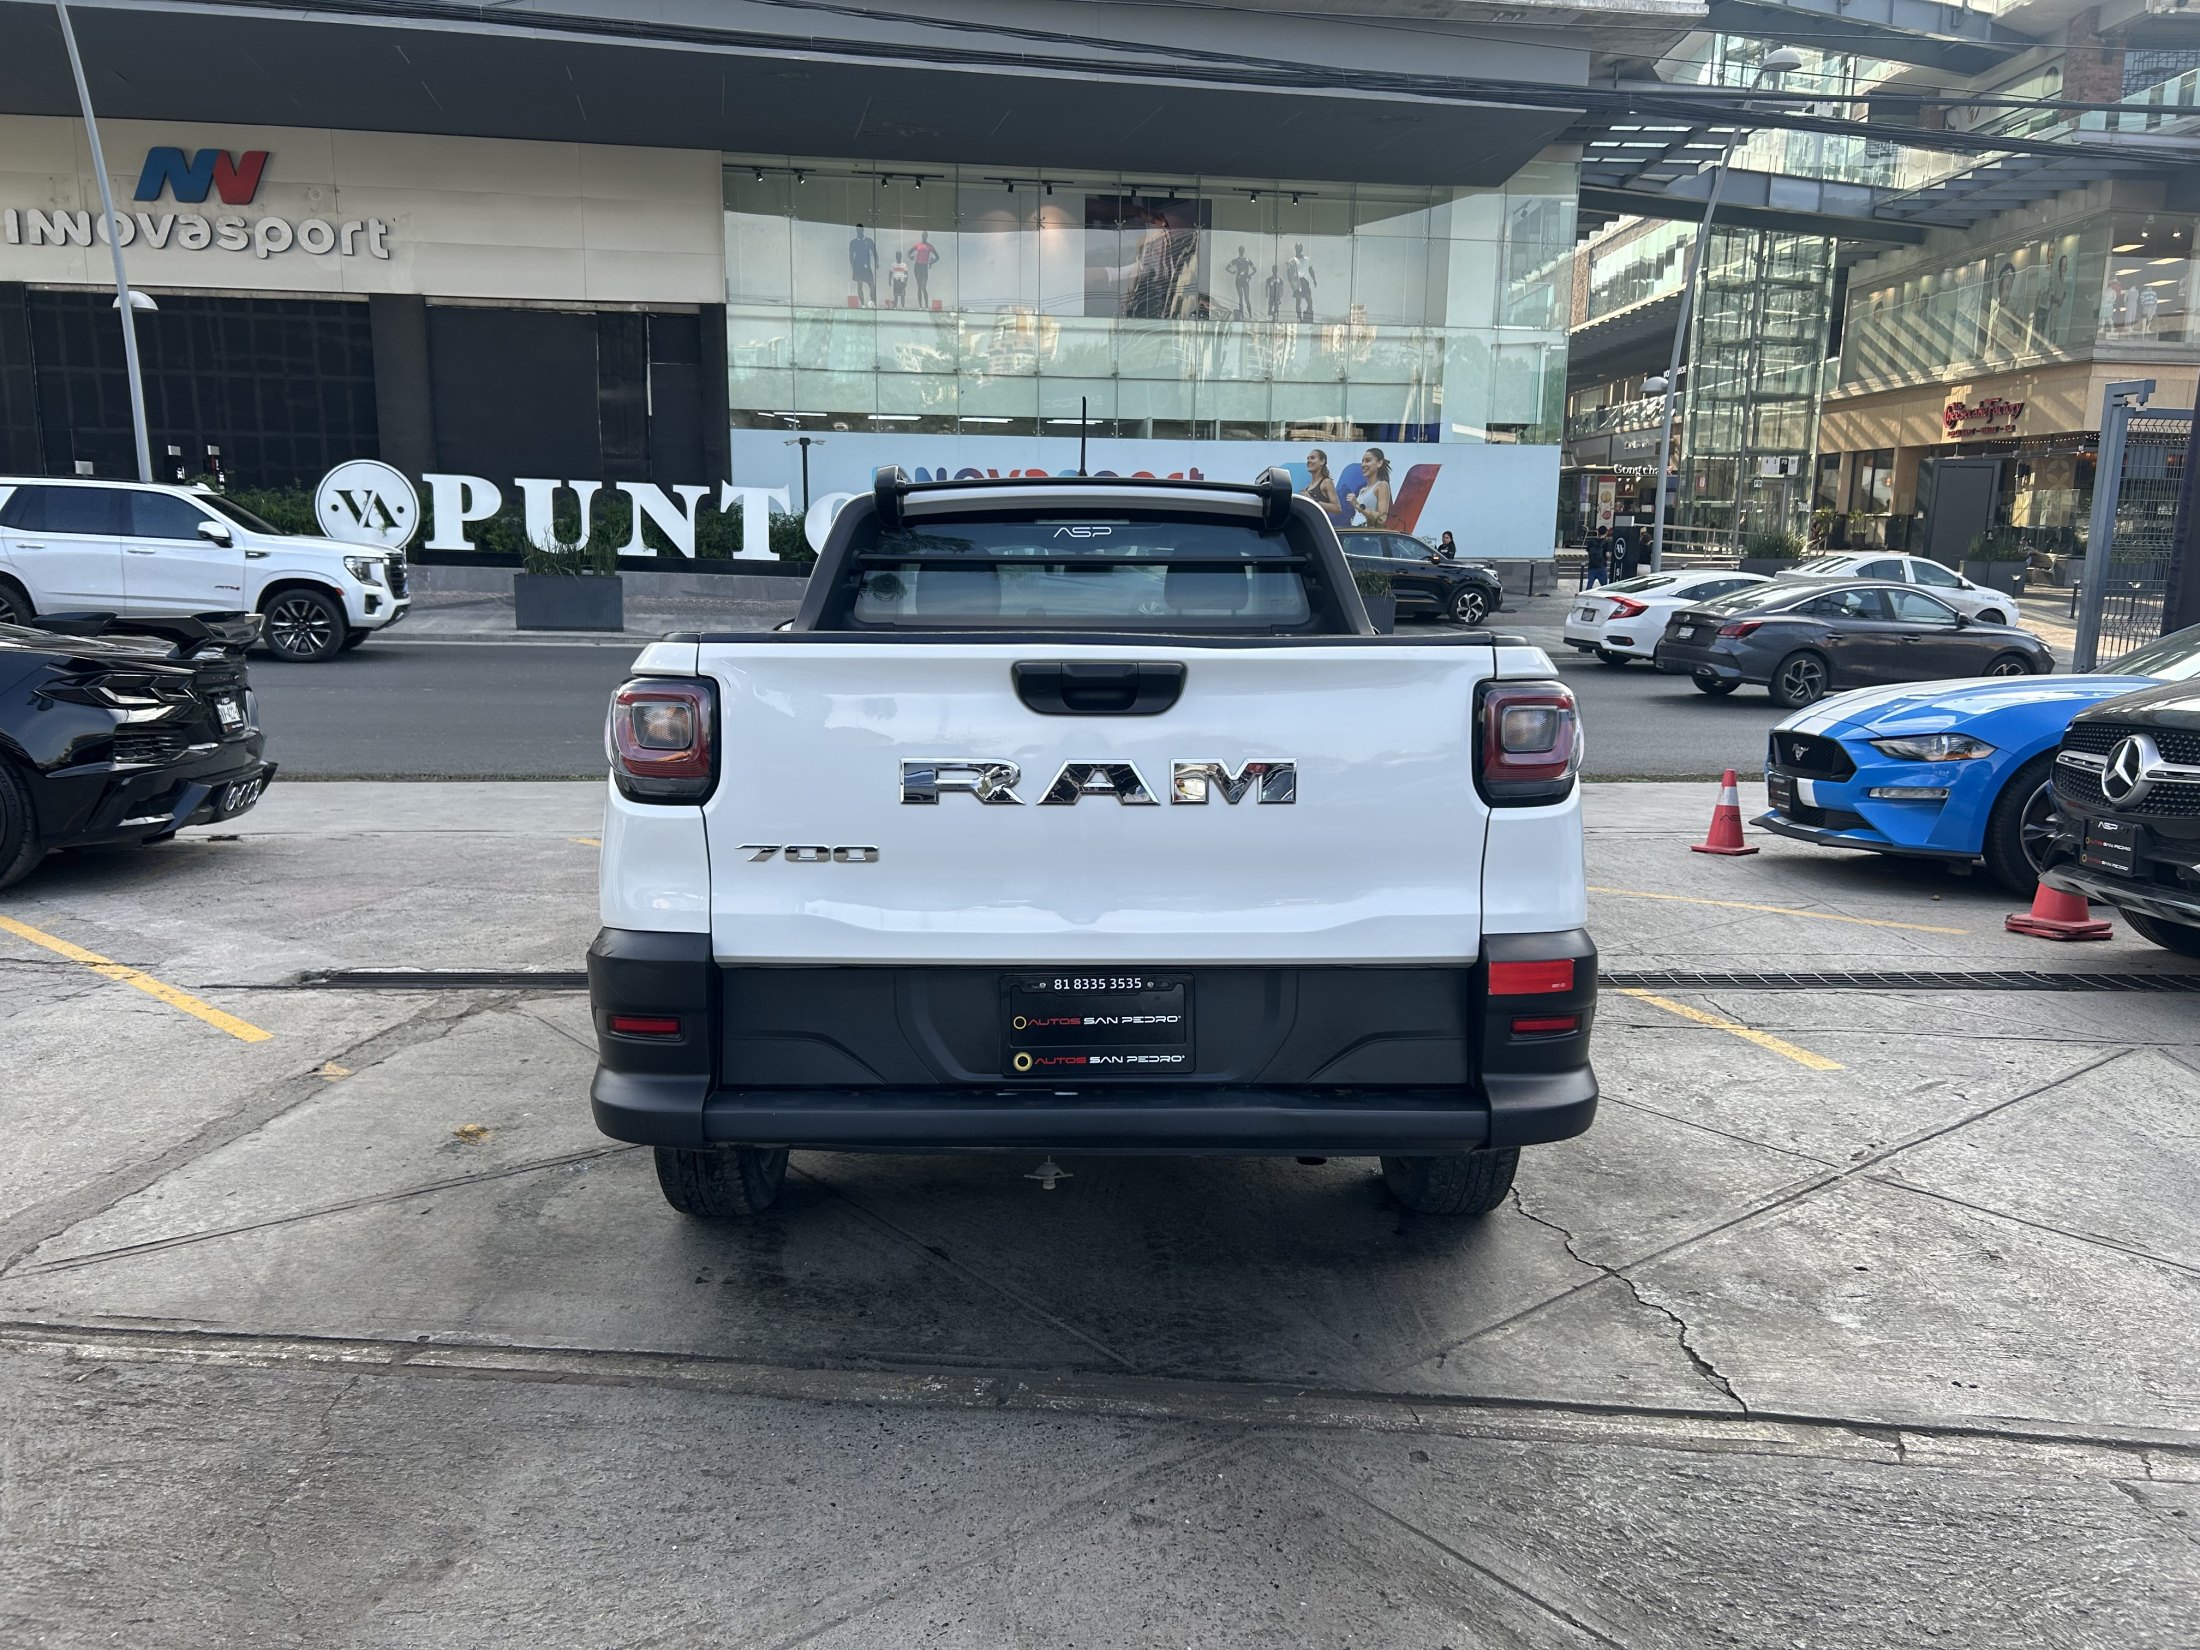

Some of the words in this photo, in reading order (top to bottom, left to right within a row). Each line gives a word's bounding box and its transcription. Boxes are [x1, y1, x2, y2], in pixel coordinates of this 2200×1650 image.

[1053, 526, 1112, 538] ASP
[900, 757, 1298, 806] RAM
[734, 843, 880, 863] 700
[1054, 979, 1070, 990] 81
[1073, 979, 1106, 990] 8335
[1109, 977, 1142, 989] 3535
[1028, 1017, 1081, 1026] AUTOS
[1083, 1016, 1118, 1025] SAN
[1034, 1056, 1086, 1065] AUTOS
[1089, 1055, 1123, 1064] SAN
